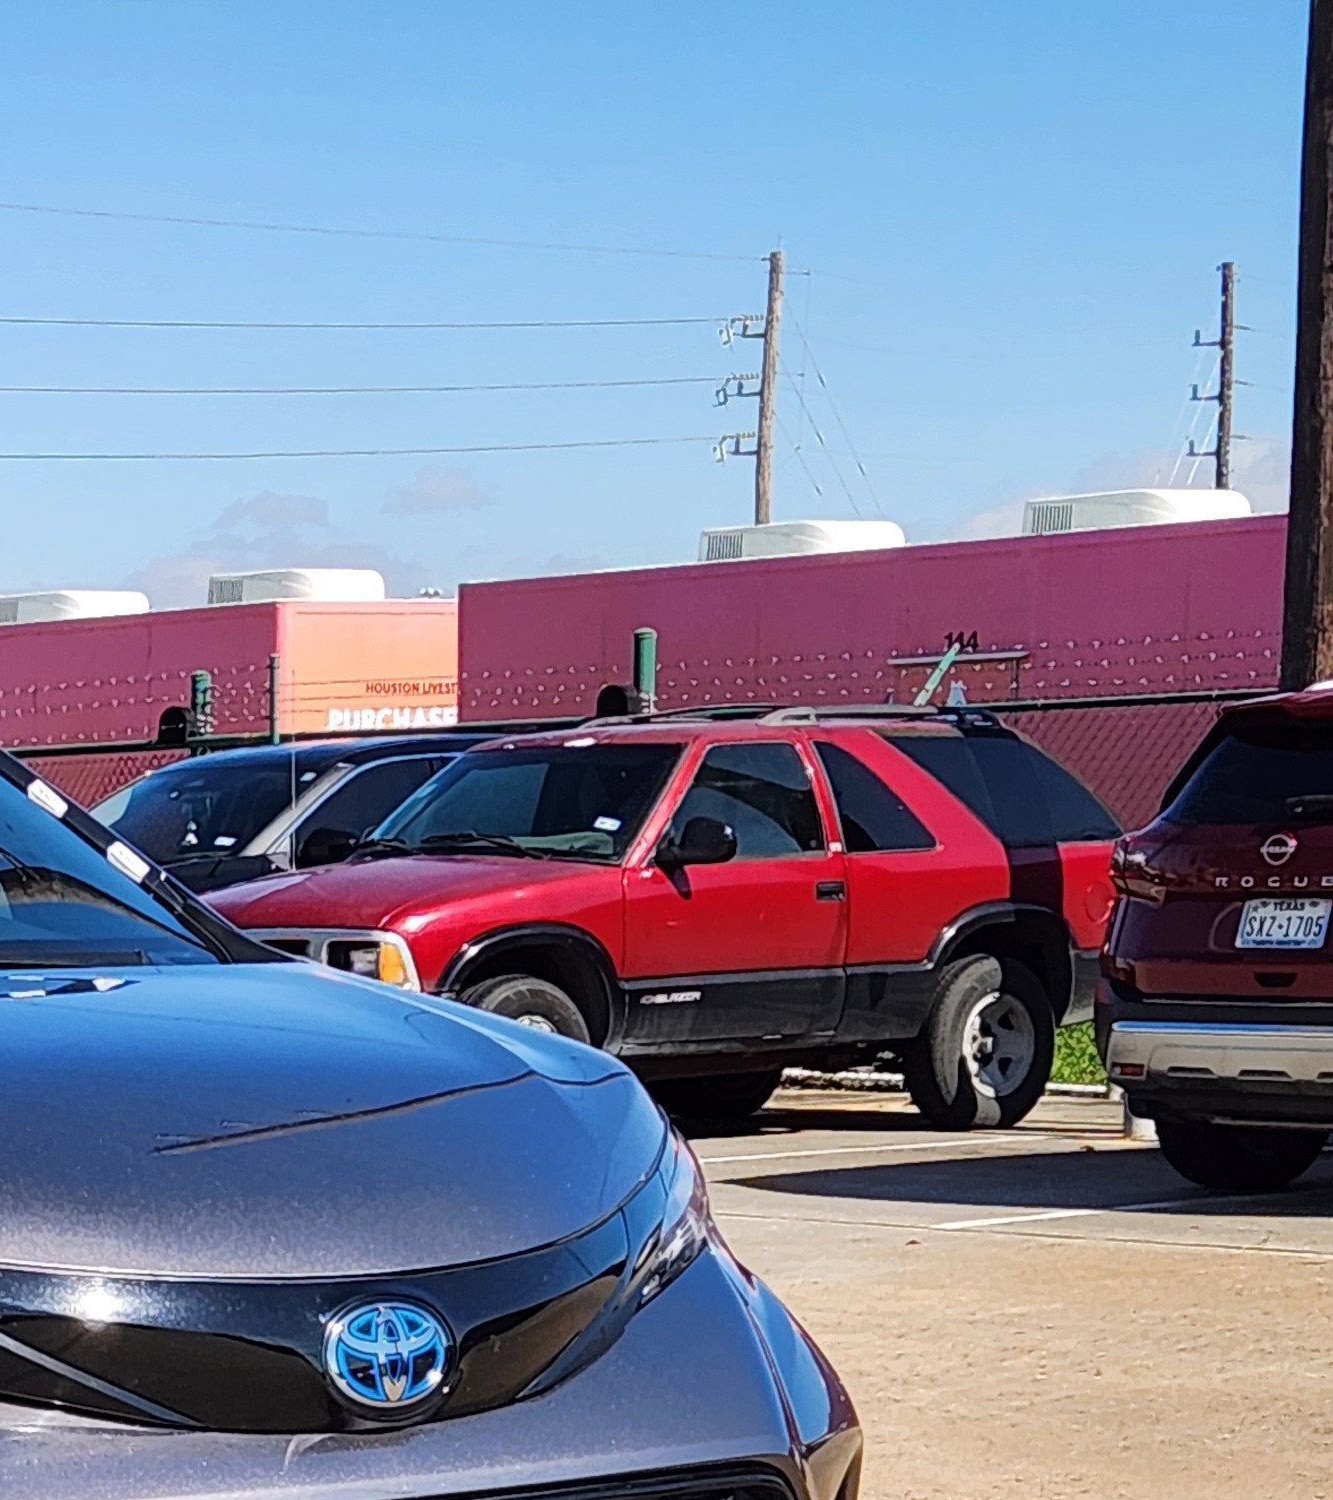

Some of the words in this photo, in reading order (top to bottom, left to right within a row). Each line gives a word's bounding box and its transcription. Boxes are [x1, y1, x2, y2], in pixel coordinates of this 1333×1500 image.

[365, 682, 420, 694] HOUSTON
[1214, 875, 1333, 888] ROGUE
[1273, 901, 1306, 911] TEXAS
